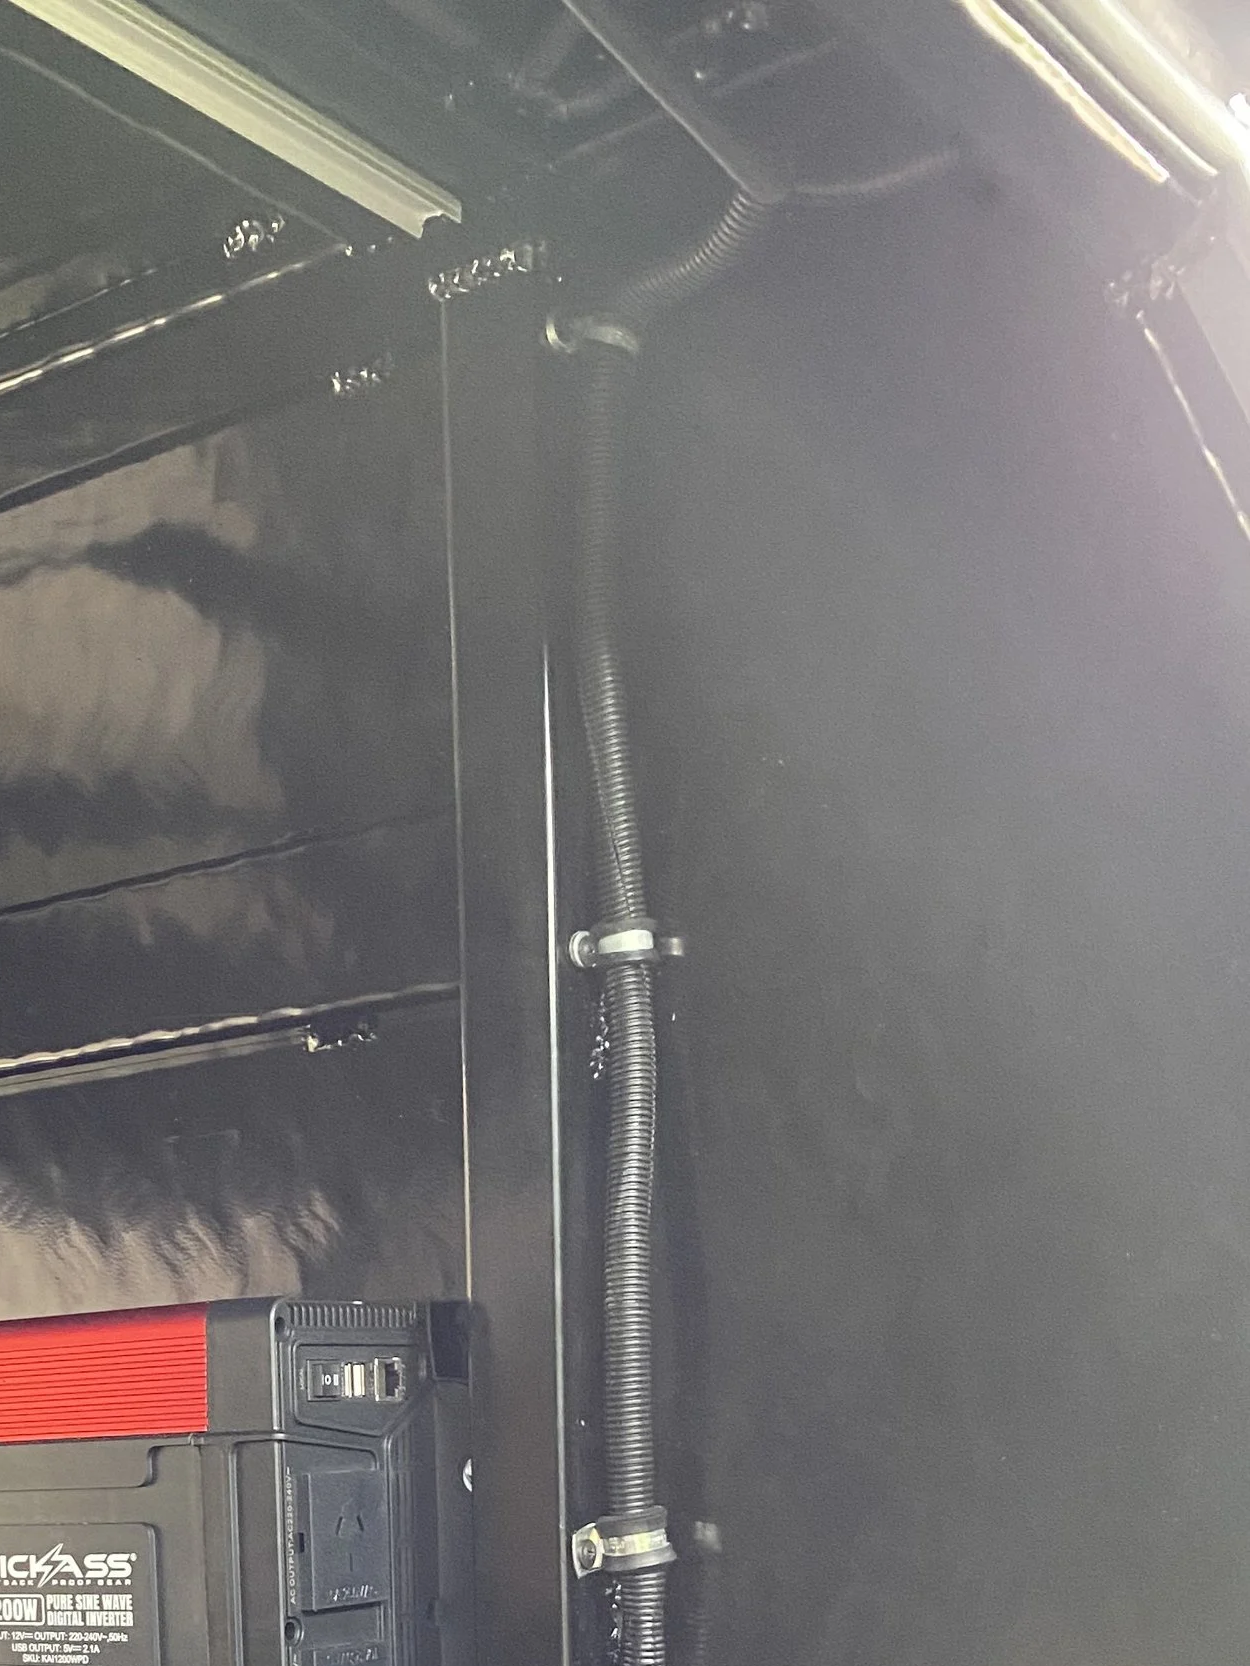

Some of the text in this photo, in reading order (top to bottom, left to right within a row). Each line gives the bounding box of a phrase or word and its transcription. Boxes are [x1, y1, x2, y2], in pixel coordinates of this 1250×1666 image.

[46, 1593, 133, 1611] PURE SINE WAVE
[47, 1610, 134, 1627] DIGITAL INVERTER
[34, 1631, 68, 1641] OUTPUT:
[11, 1643, 28, 1652] USB
[28, 1643, 62, 1652] OUTPUT:
[82, 1645, 100, 1654] 2.1A
[22, 1654, 41, 1663] SKU:
